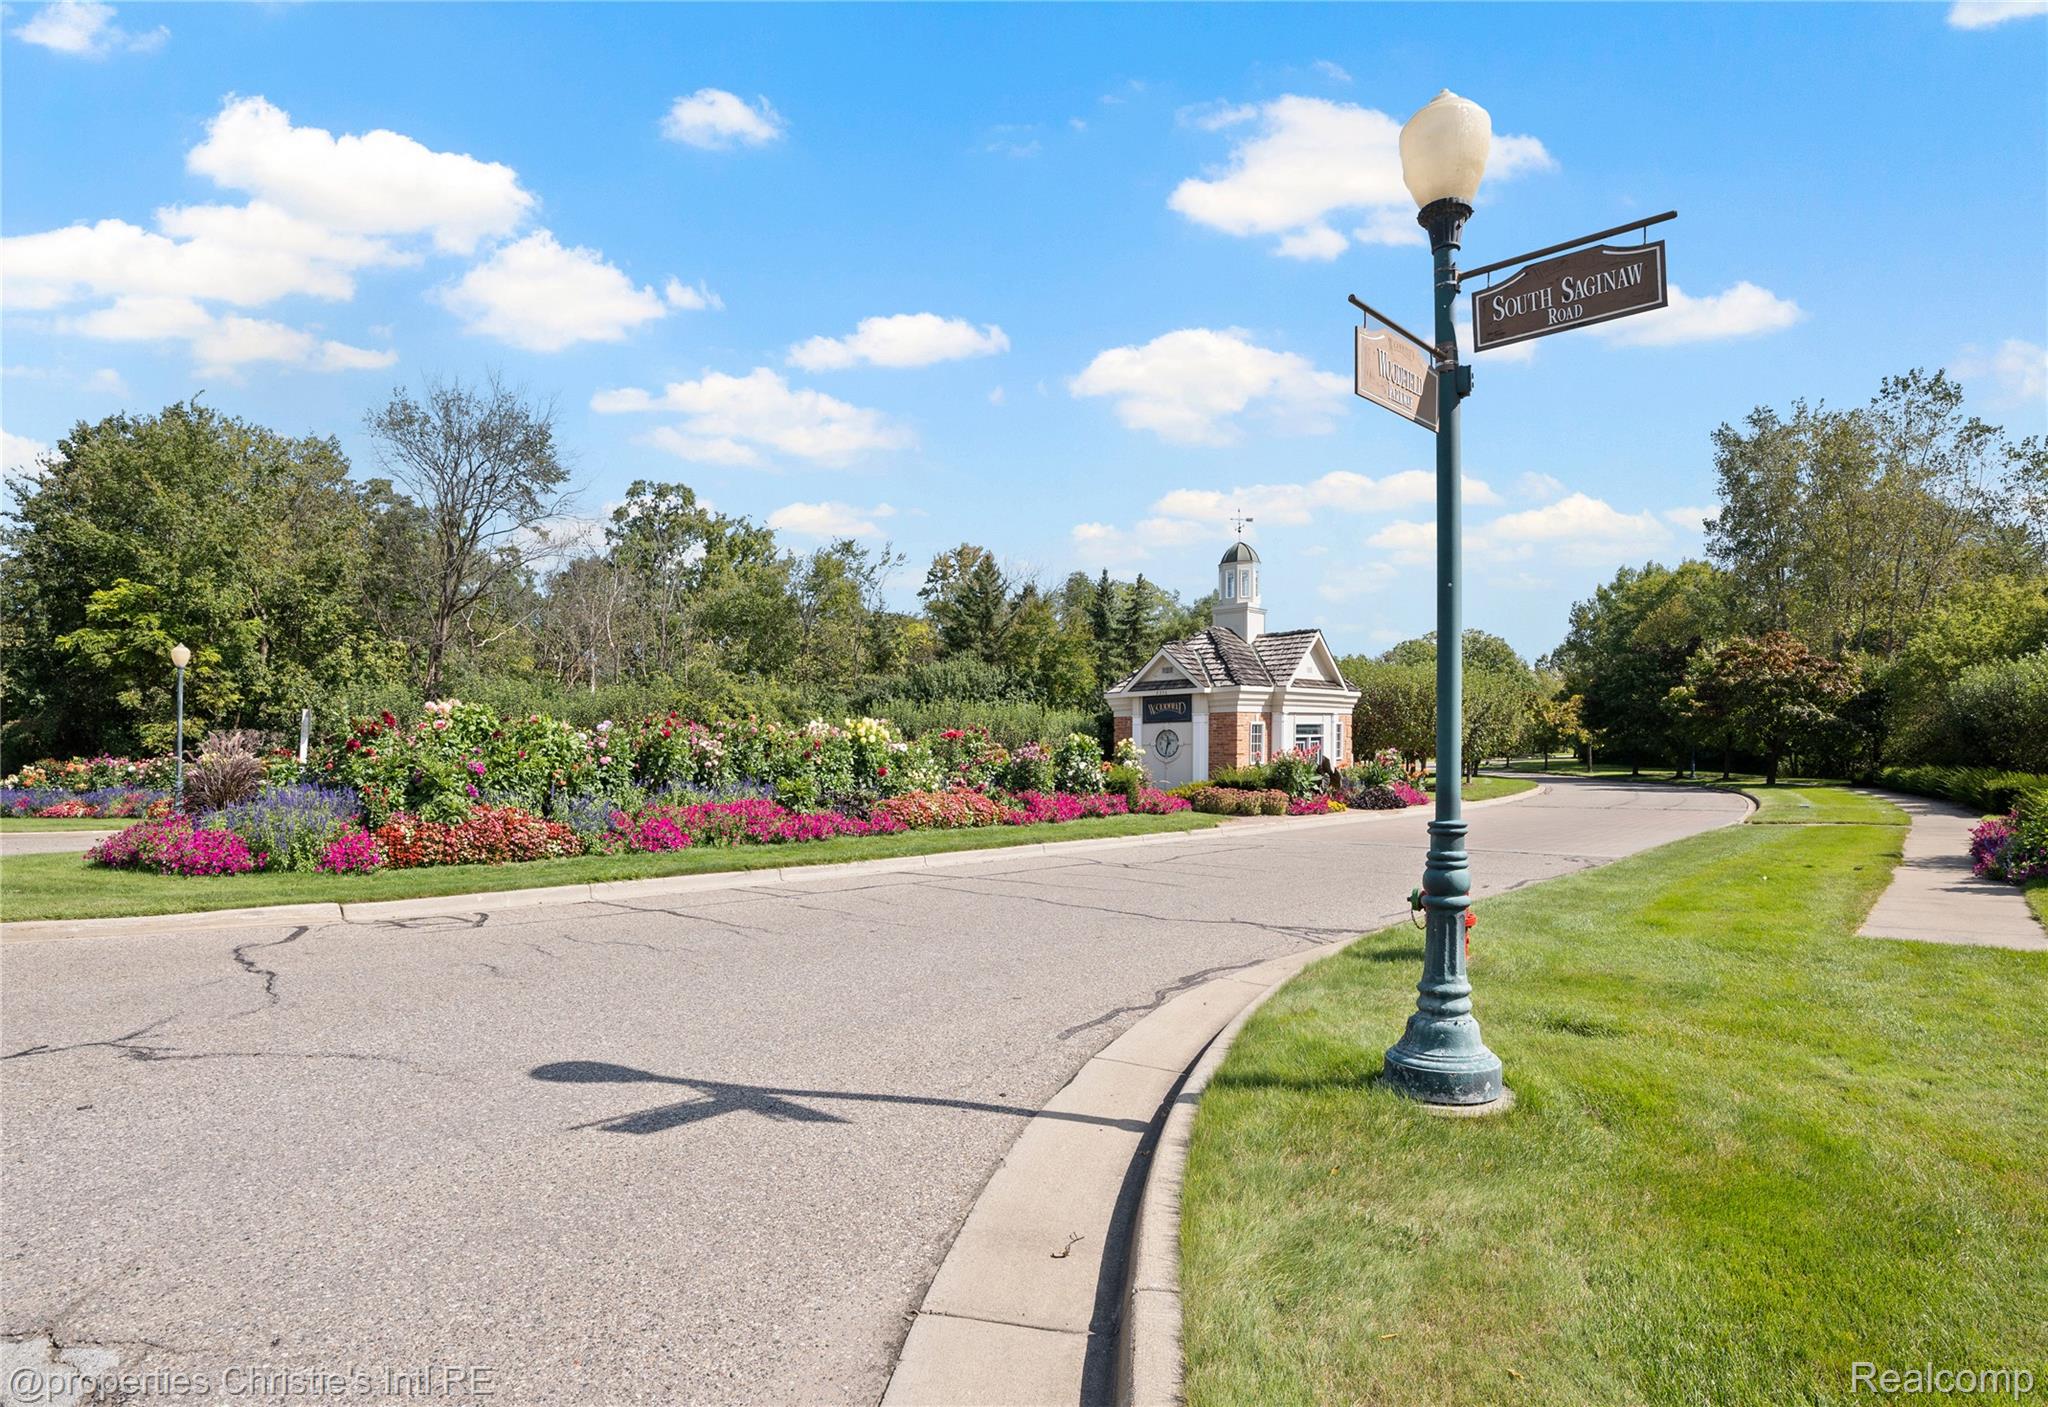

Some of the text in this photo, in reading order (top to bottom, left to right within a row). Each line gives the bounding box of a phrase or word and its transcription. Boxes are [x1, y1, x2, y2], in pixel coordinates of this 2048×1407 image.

[1492, 262, 1644, 322] SOUTH SAGINAW
[1548, 304, 1583, 326] ROAD
